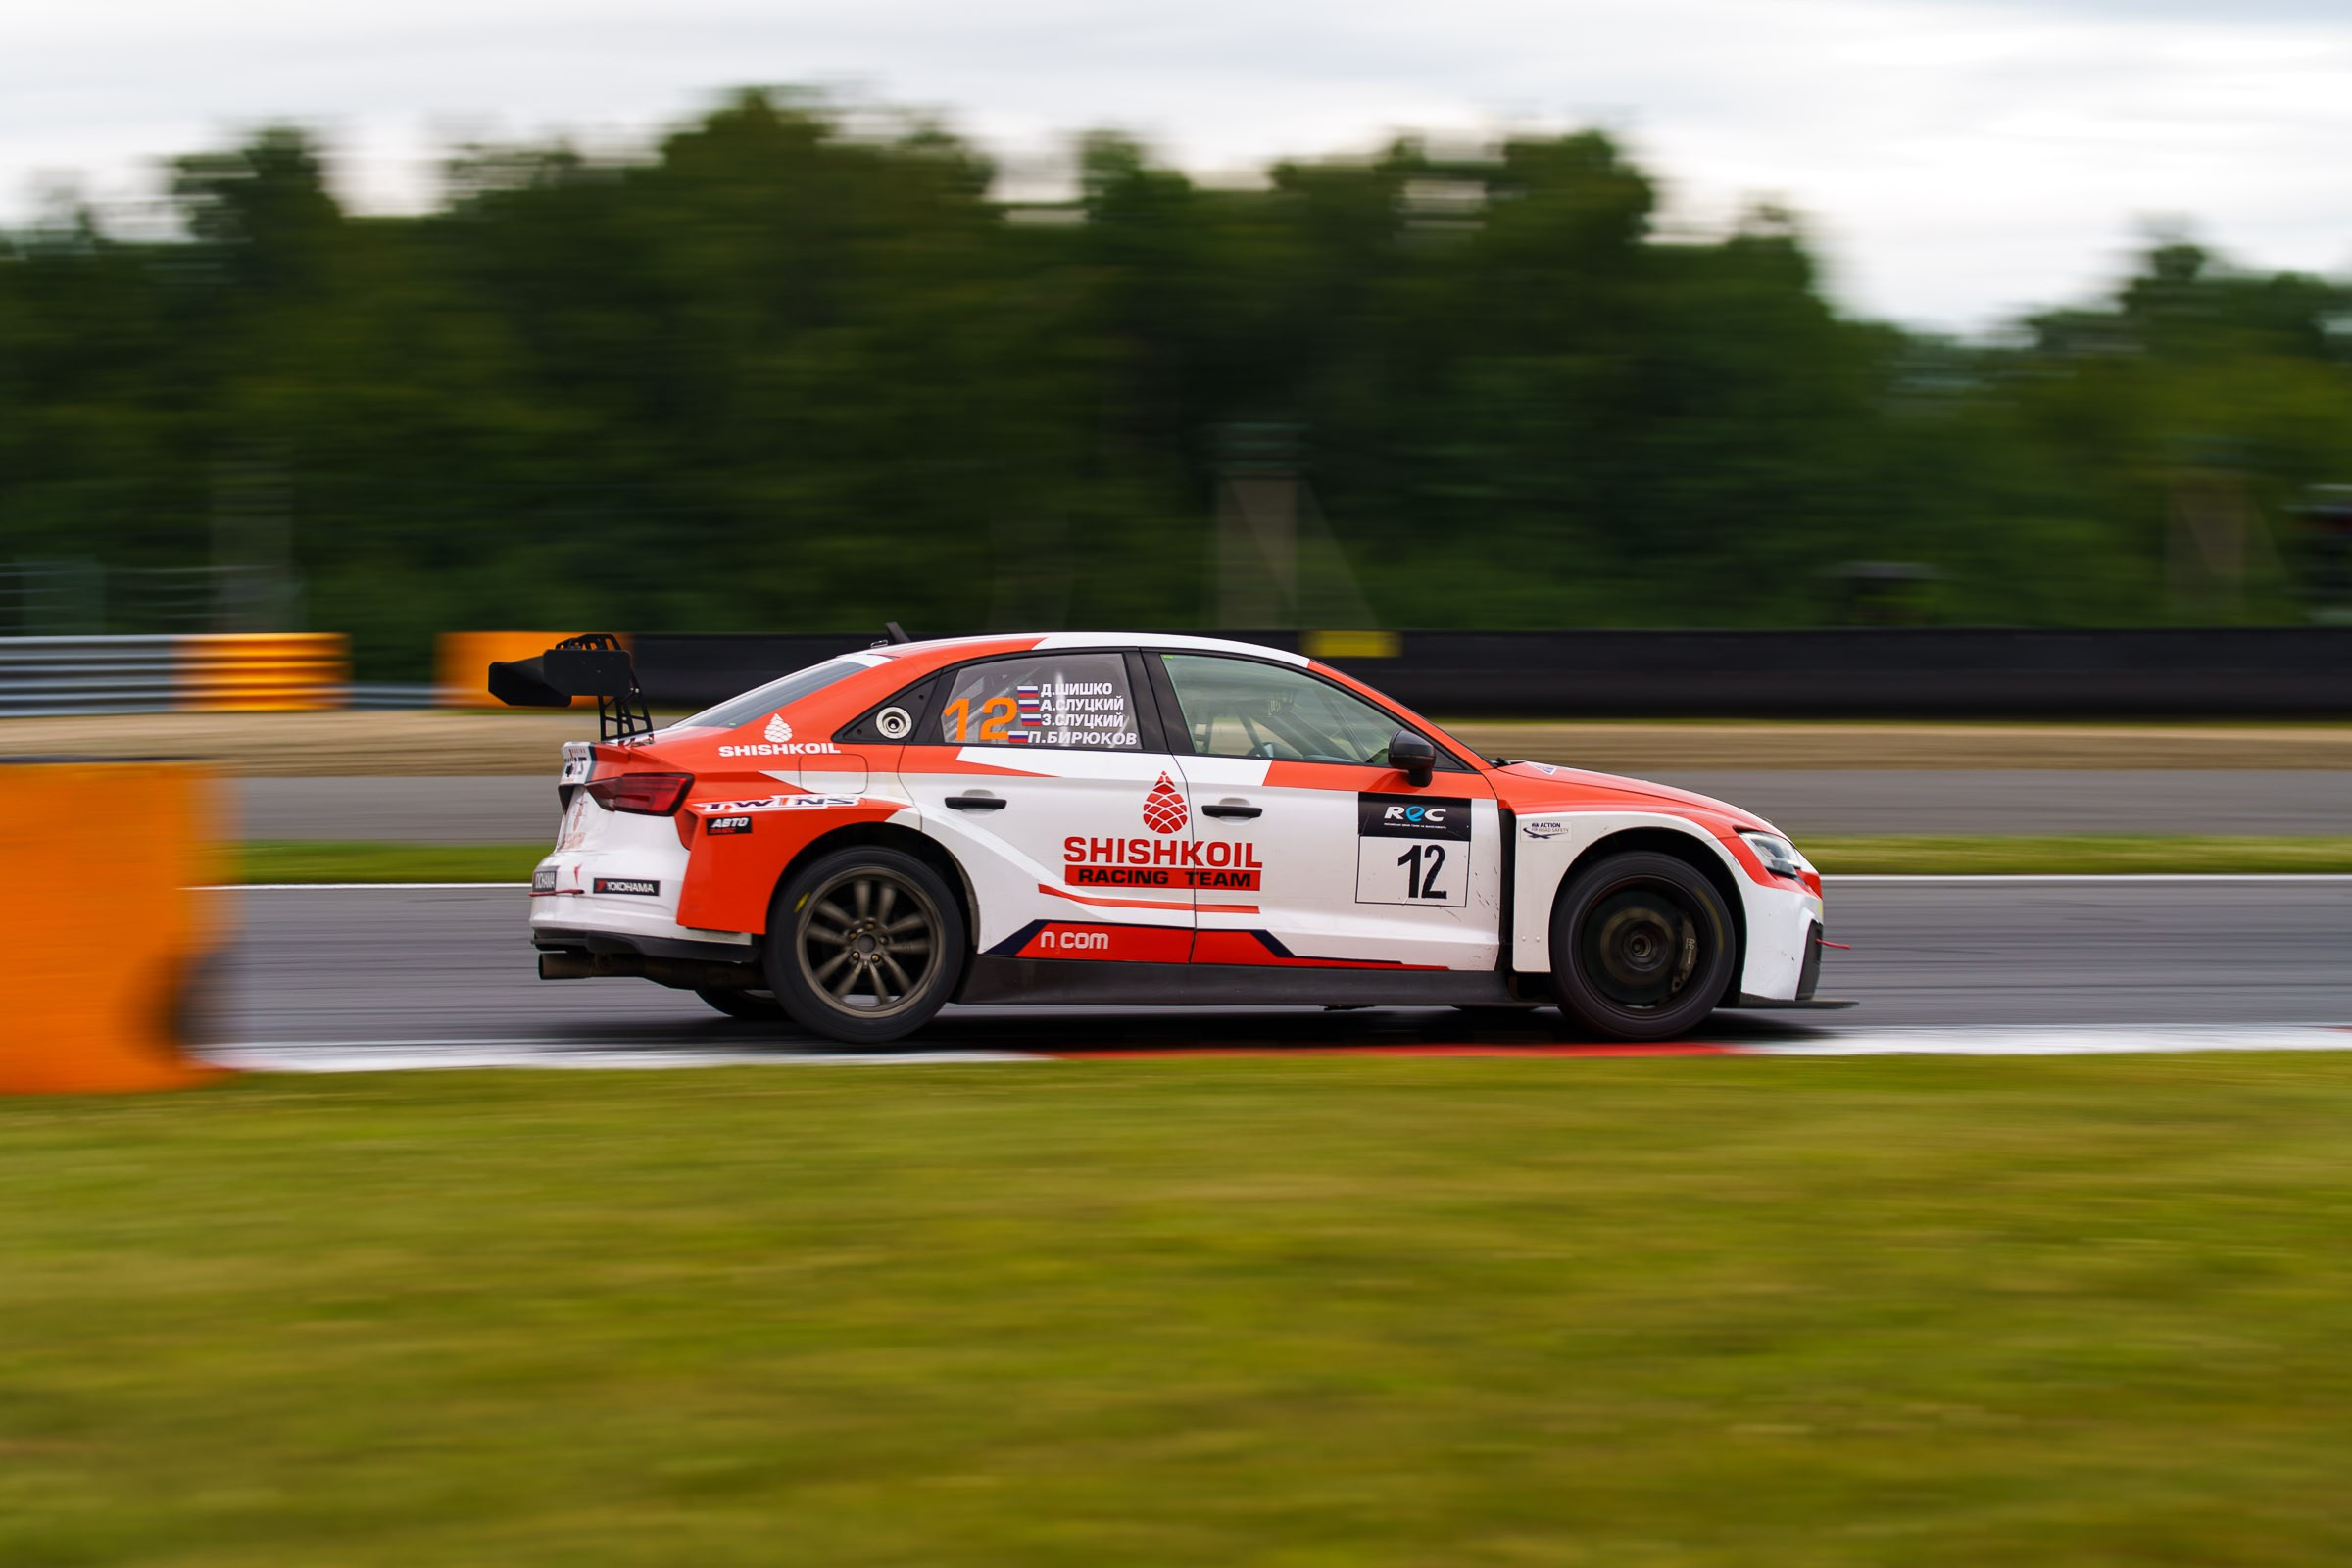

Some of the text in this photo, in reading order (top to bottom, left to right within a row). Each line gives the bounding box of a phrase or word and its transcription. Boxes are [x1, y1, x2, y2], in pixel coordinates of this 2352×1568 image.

[1040, 683, 1113, 698] Д.ШИШКО
[1039, 696, 1124, 712] А.СЛУЦКИЙ
[942, 697, 1018, 741] 12
[1041, 712, 1124, 727] З.СЛУЦКИЙ
[1028, 731, 1138, 746] П.БИРЮКОВ
[717, 742, 842, 758] SHISHKOIL
[694, 794, 860, 813] TWINS
[711, 817, 749, 828] АВТО
[1063, 836, 1263, 868] SHISHKOIL
[1078, 868, 1251, 887] RACING TEAM
[1397, 844, 1447, 900] 12
[607, 881, 655, 893] YOKOHAMA
